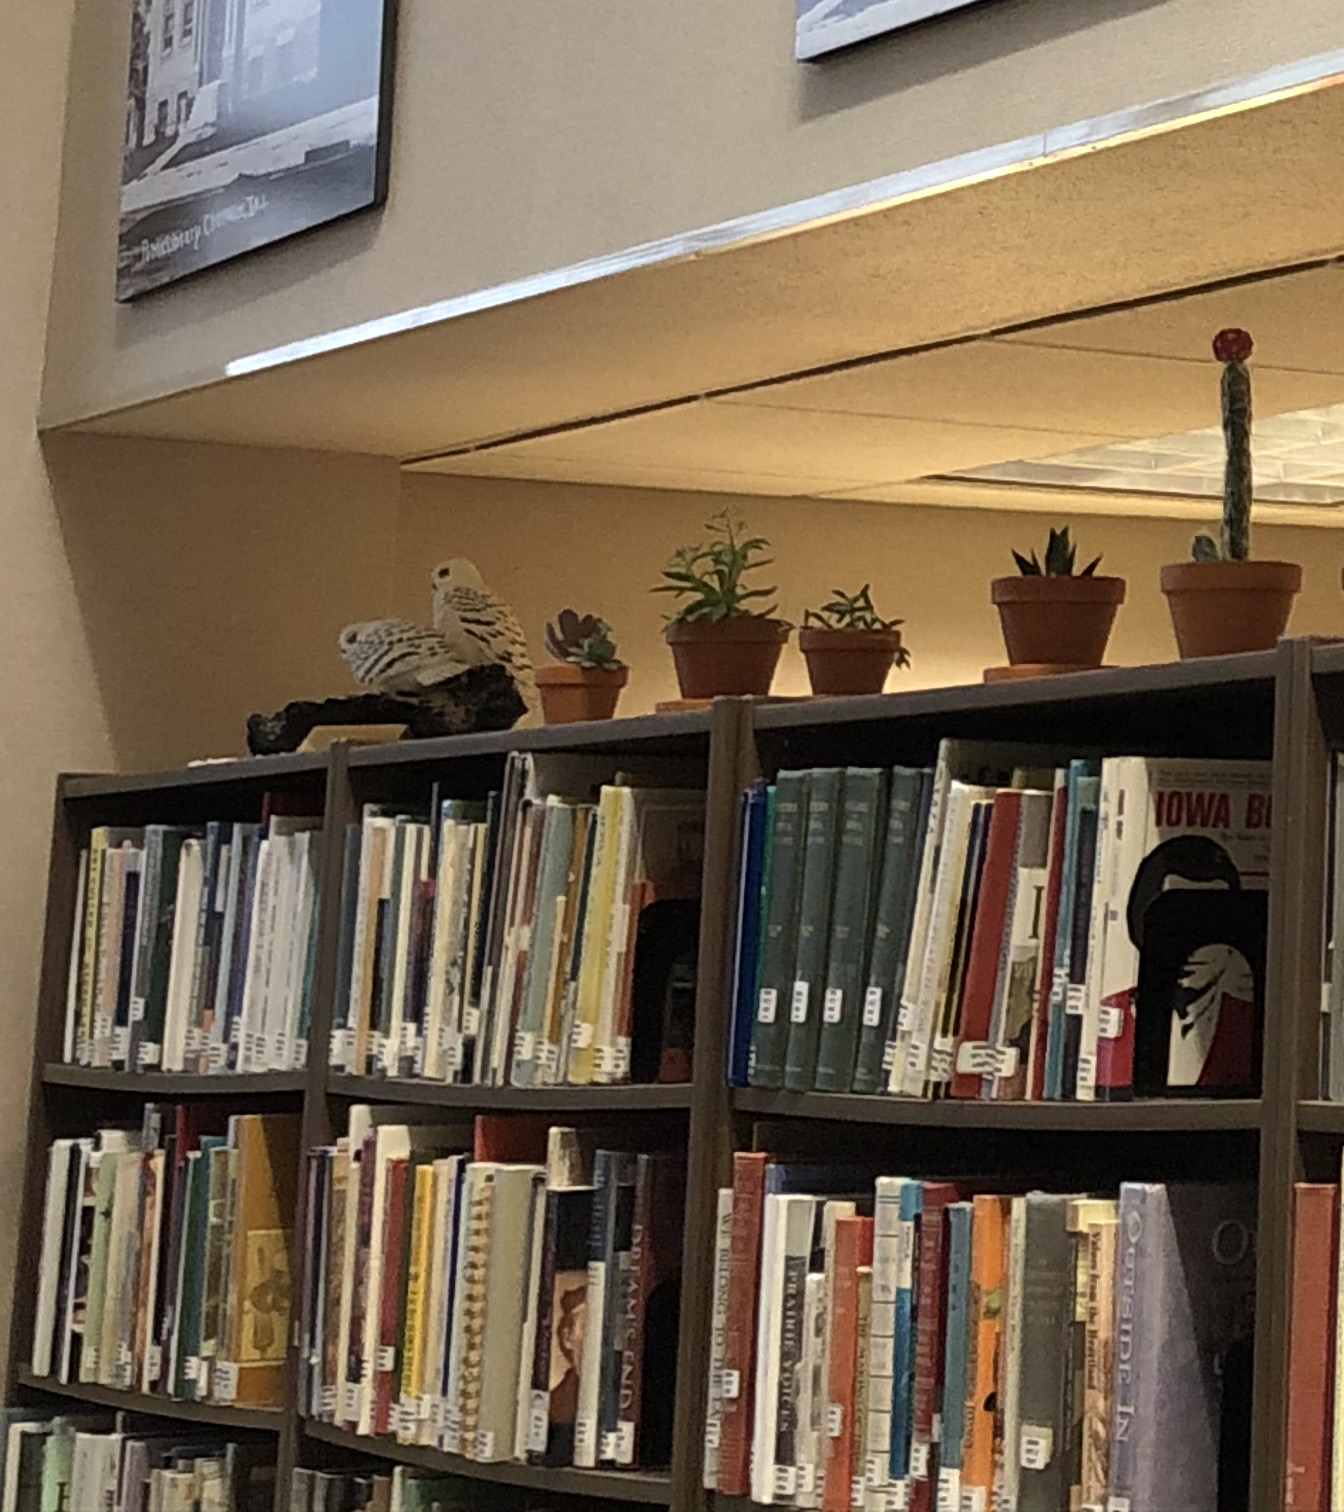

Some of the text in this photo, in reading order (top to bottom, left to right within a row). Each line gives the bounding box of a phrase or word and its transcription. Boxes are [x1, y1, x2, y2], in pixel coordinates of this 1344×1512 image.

[1156, 790, 1230, 828] IOWA
[1086, 1230, 1101, 1390] Values from the Heartland
[1115, 1209, 1142, 1444] OUTSIDE IN
